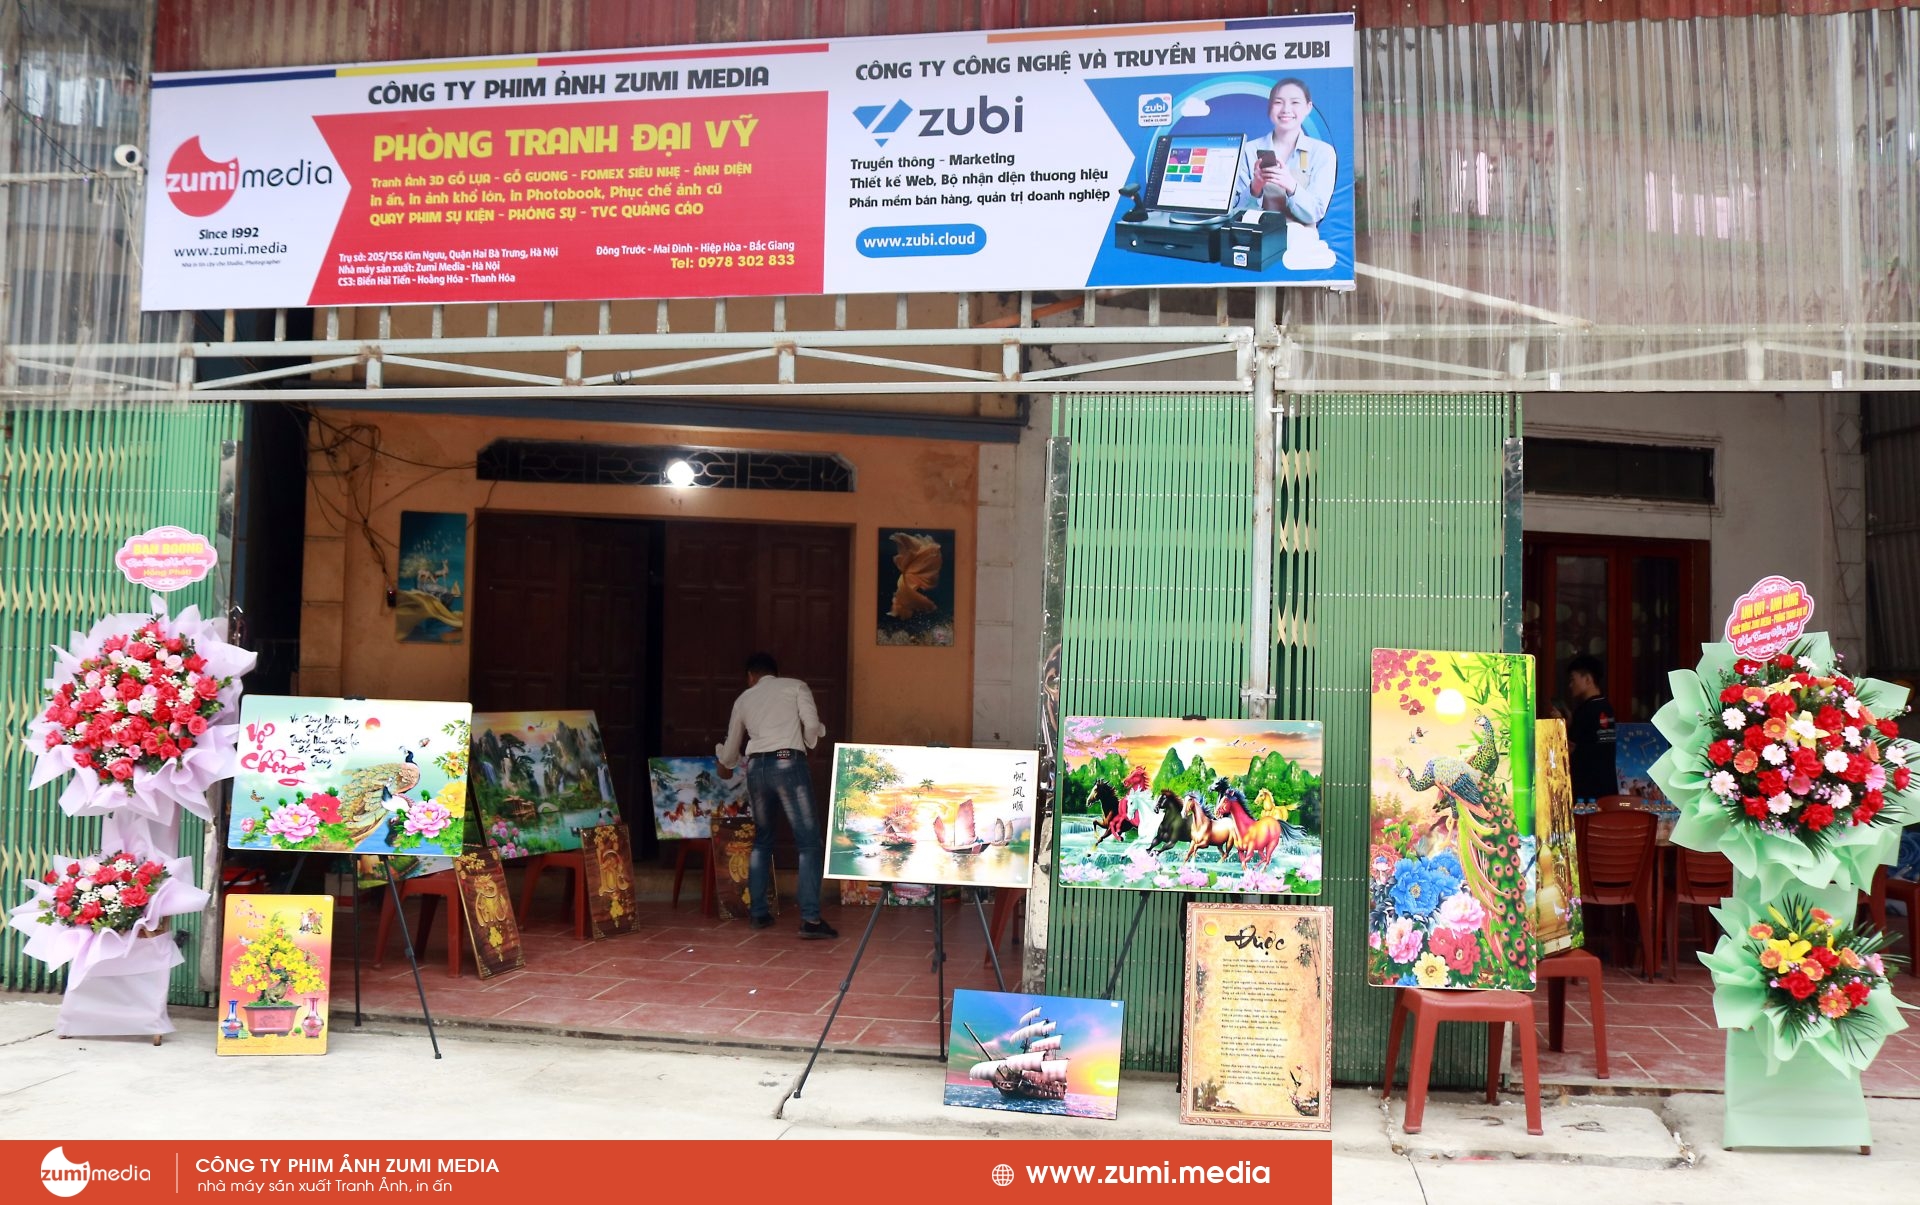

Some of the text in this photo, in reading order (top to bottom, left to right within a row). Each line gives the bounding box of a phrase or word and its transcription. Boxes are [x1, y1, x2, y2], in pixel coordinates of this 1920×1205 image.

[856, 40, 1331, 80] CÔNG TY CÔNG NGHỆ VÀ TRUYỀN THÔNG ZUBI
[368, 66, 769, 104] CÔNG TY PHIM ẢNH ZUMI MEDIA
[918, 95, 1024, 137] zubi
[373, 114, 759, 162] PHÒNG TRANH ĐẠI VỸ
[898, 156, 935, 169] thông
[950, 153, 1015, 166] Marketing
[850, 176, 882, 188] Thiết
[886, 174, 901, 188] kế
[906, 176, 936, 186] Web,
[942, 174, 958, 188] Bộ
[962, 172, 993, 186] nhận
[998, 171, 1025, 186] diện
[1080, 168, 1108, 182] hiệu
[370, 194, 382, 206] in
[409, 192, 420, 204] in
[425, 192, 448, 204] ảnh
[510, 189, 522, 202] in
[526, 186, 605, 200] Photobook,
[610, 186, 642, 200] Phục
[648, 182, 672, 196] chế
[676, 182, 702, 196] ảnh
[706, 182, 722, 195] cũ
[370, 212, 404, 226] QUAY
[408, 211, 442, 224] PHIM
[466, 208, 494, 224] KIỆN
[591, 206, 618, 218] TVC
[199, 227, 259, 239] Since 1992
[864, 232, 976, 248] www.zubi.cloud
[174, 242, 287, 256] www.zumi.media
[670, 254, 795, 268] Tel: 0978 302 833
[1013, 762, 1027, 812] 一帆风顺
